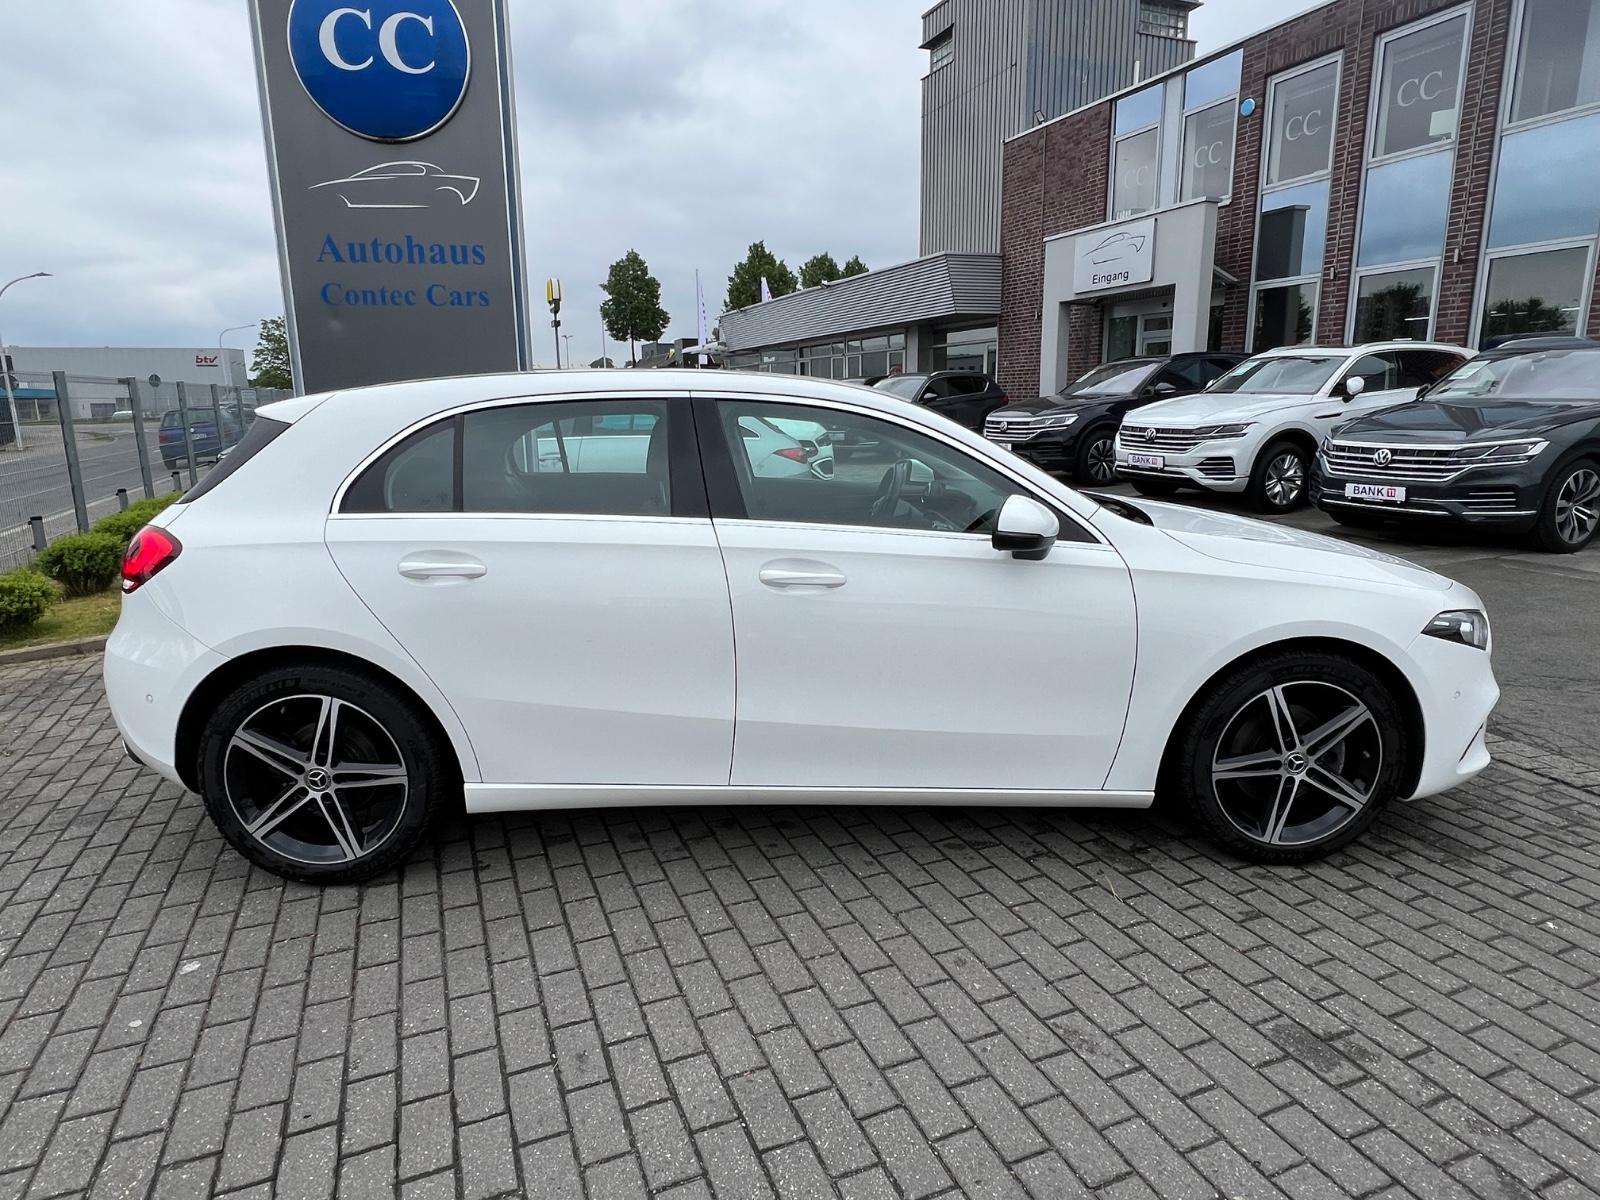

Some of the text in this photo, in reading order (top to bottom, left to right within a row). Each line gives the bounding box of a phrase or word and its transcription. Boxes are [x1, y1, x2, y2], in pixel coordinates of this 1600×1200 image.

[319, 7, 435, 75] CC
[1397, 71, 1443, 107] CC
[1285, 109, 1321, 141] CC
[1194, 141, 1223, 168] CC
[317, 233, 486, 266] Autohaus
[1092, 271, 1129, 285] Eingang
[320, 282, 490, 307] Contec Cars
[195, 355, 218, 364] btv
[1132, 456, 1150, 465] BANK
[1353, 486, 1384, 497] BANK
